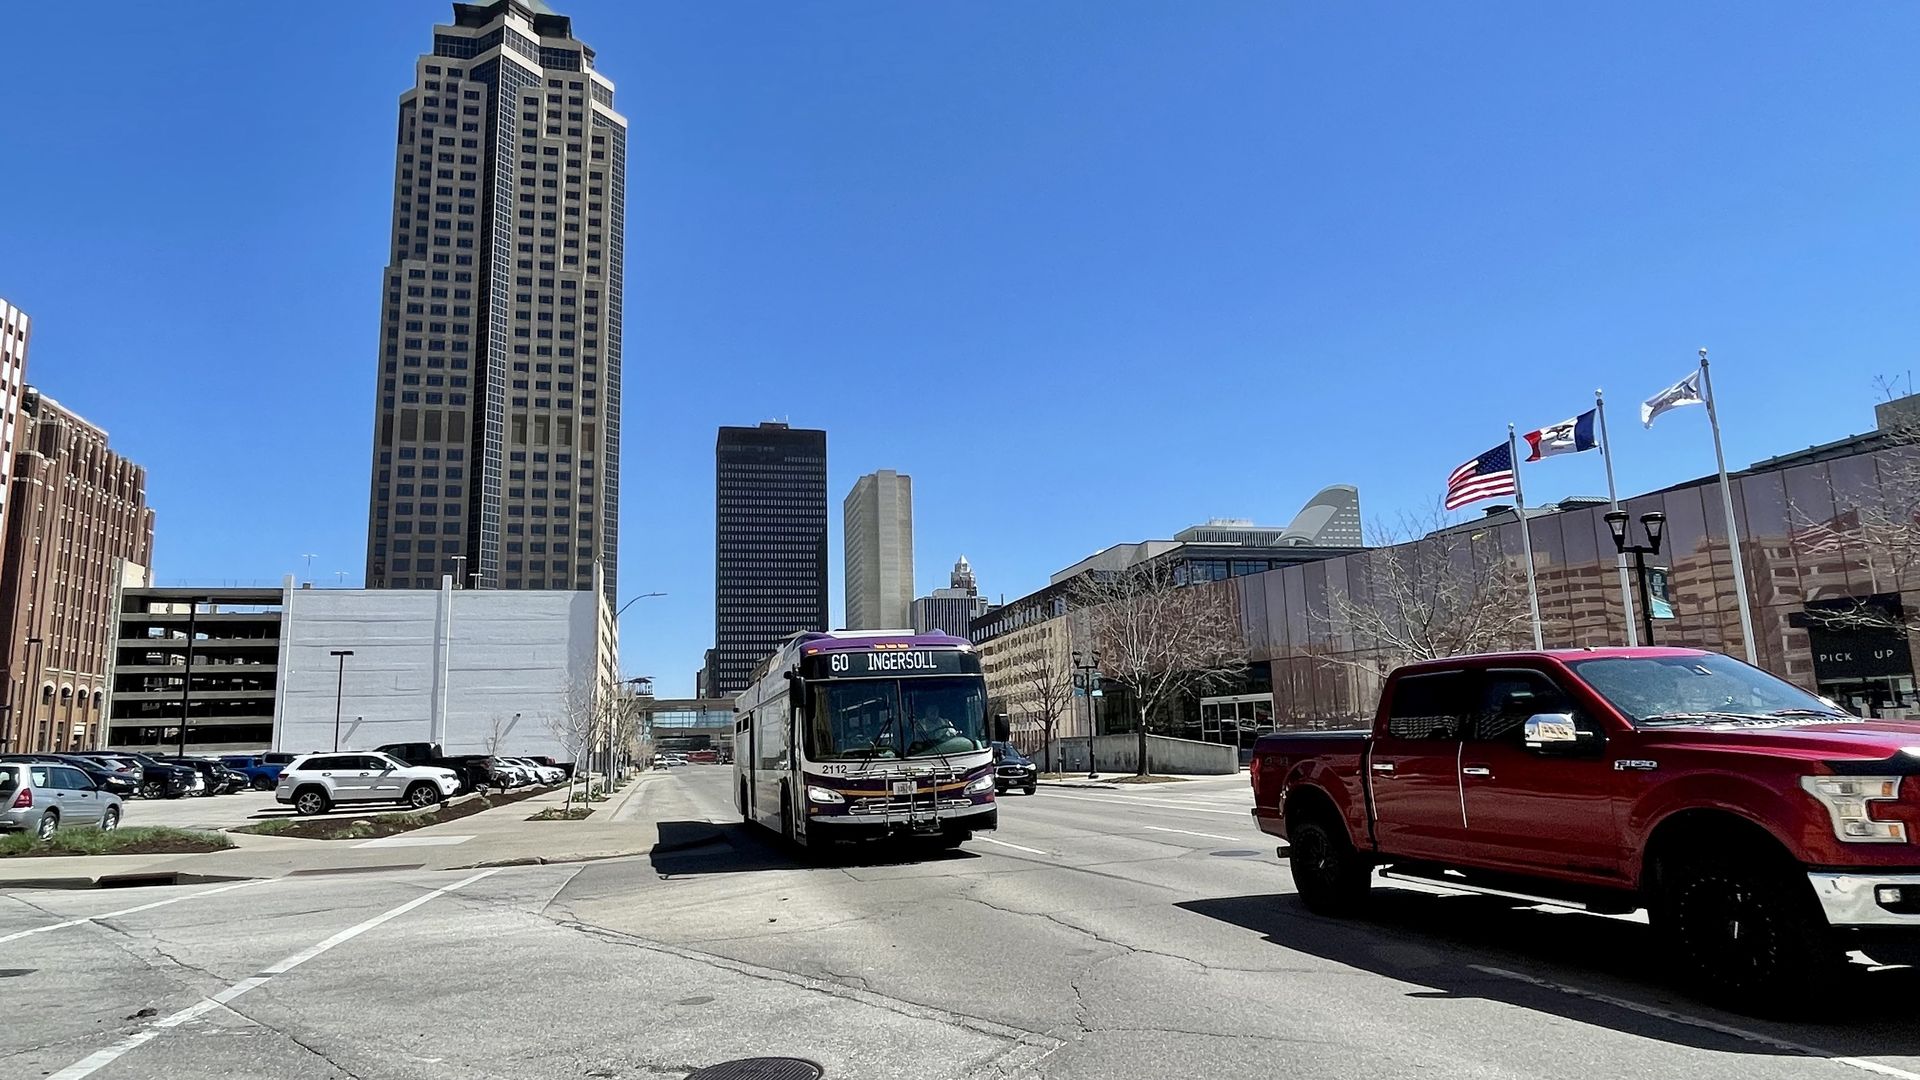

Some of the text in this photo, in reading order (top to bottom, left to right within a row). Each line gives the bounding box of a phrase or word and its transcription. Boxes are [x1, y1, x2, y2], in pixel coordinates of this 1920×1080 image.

[831, 651, 938, 672] 60 INGERSOLL
[1819, 649, 1894, 663] PICK UP
[822, 764, 848, 775] 2112
